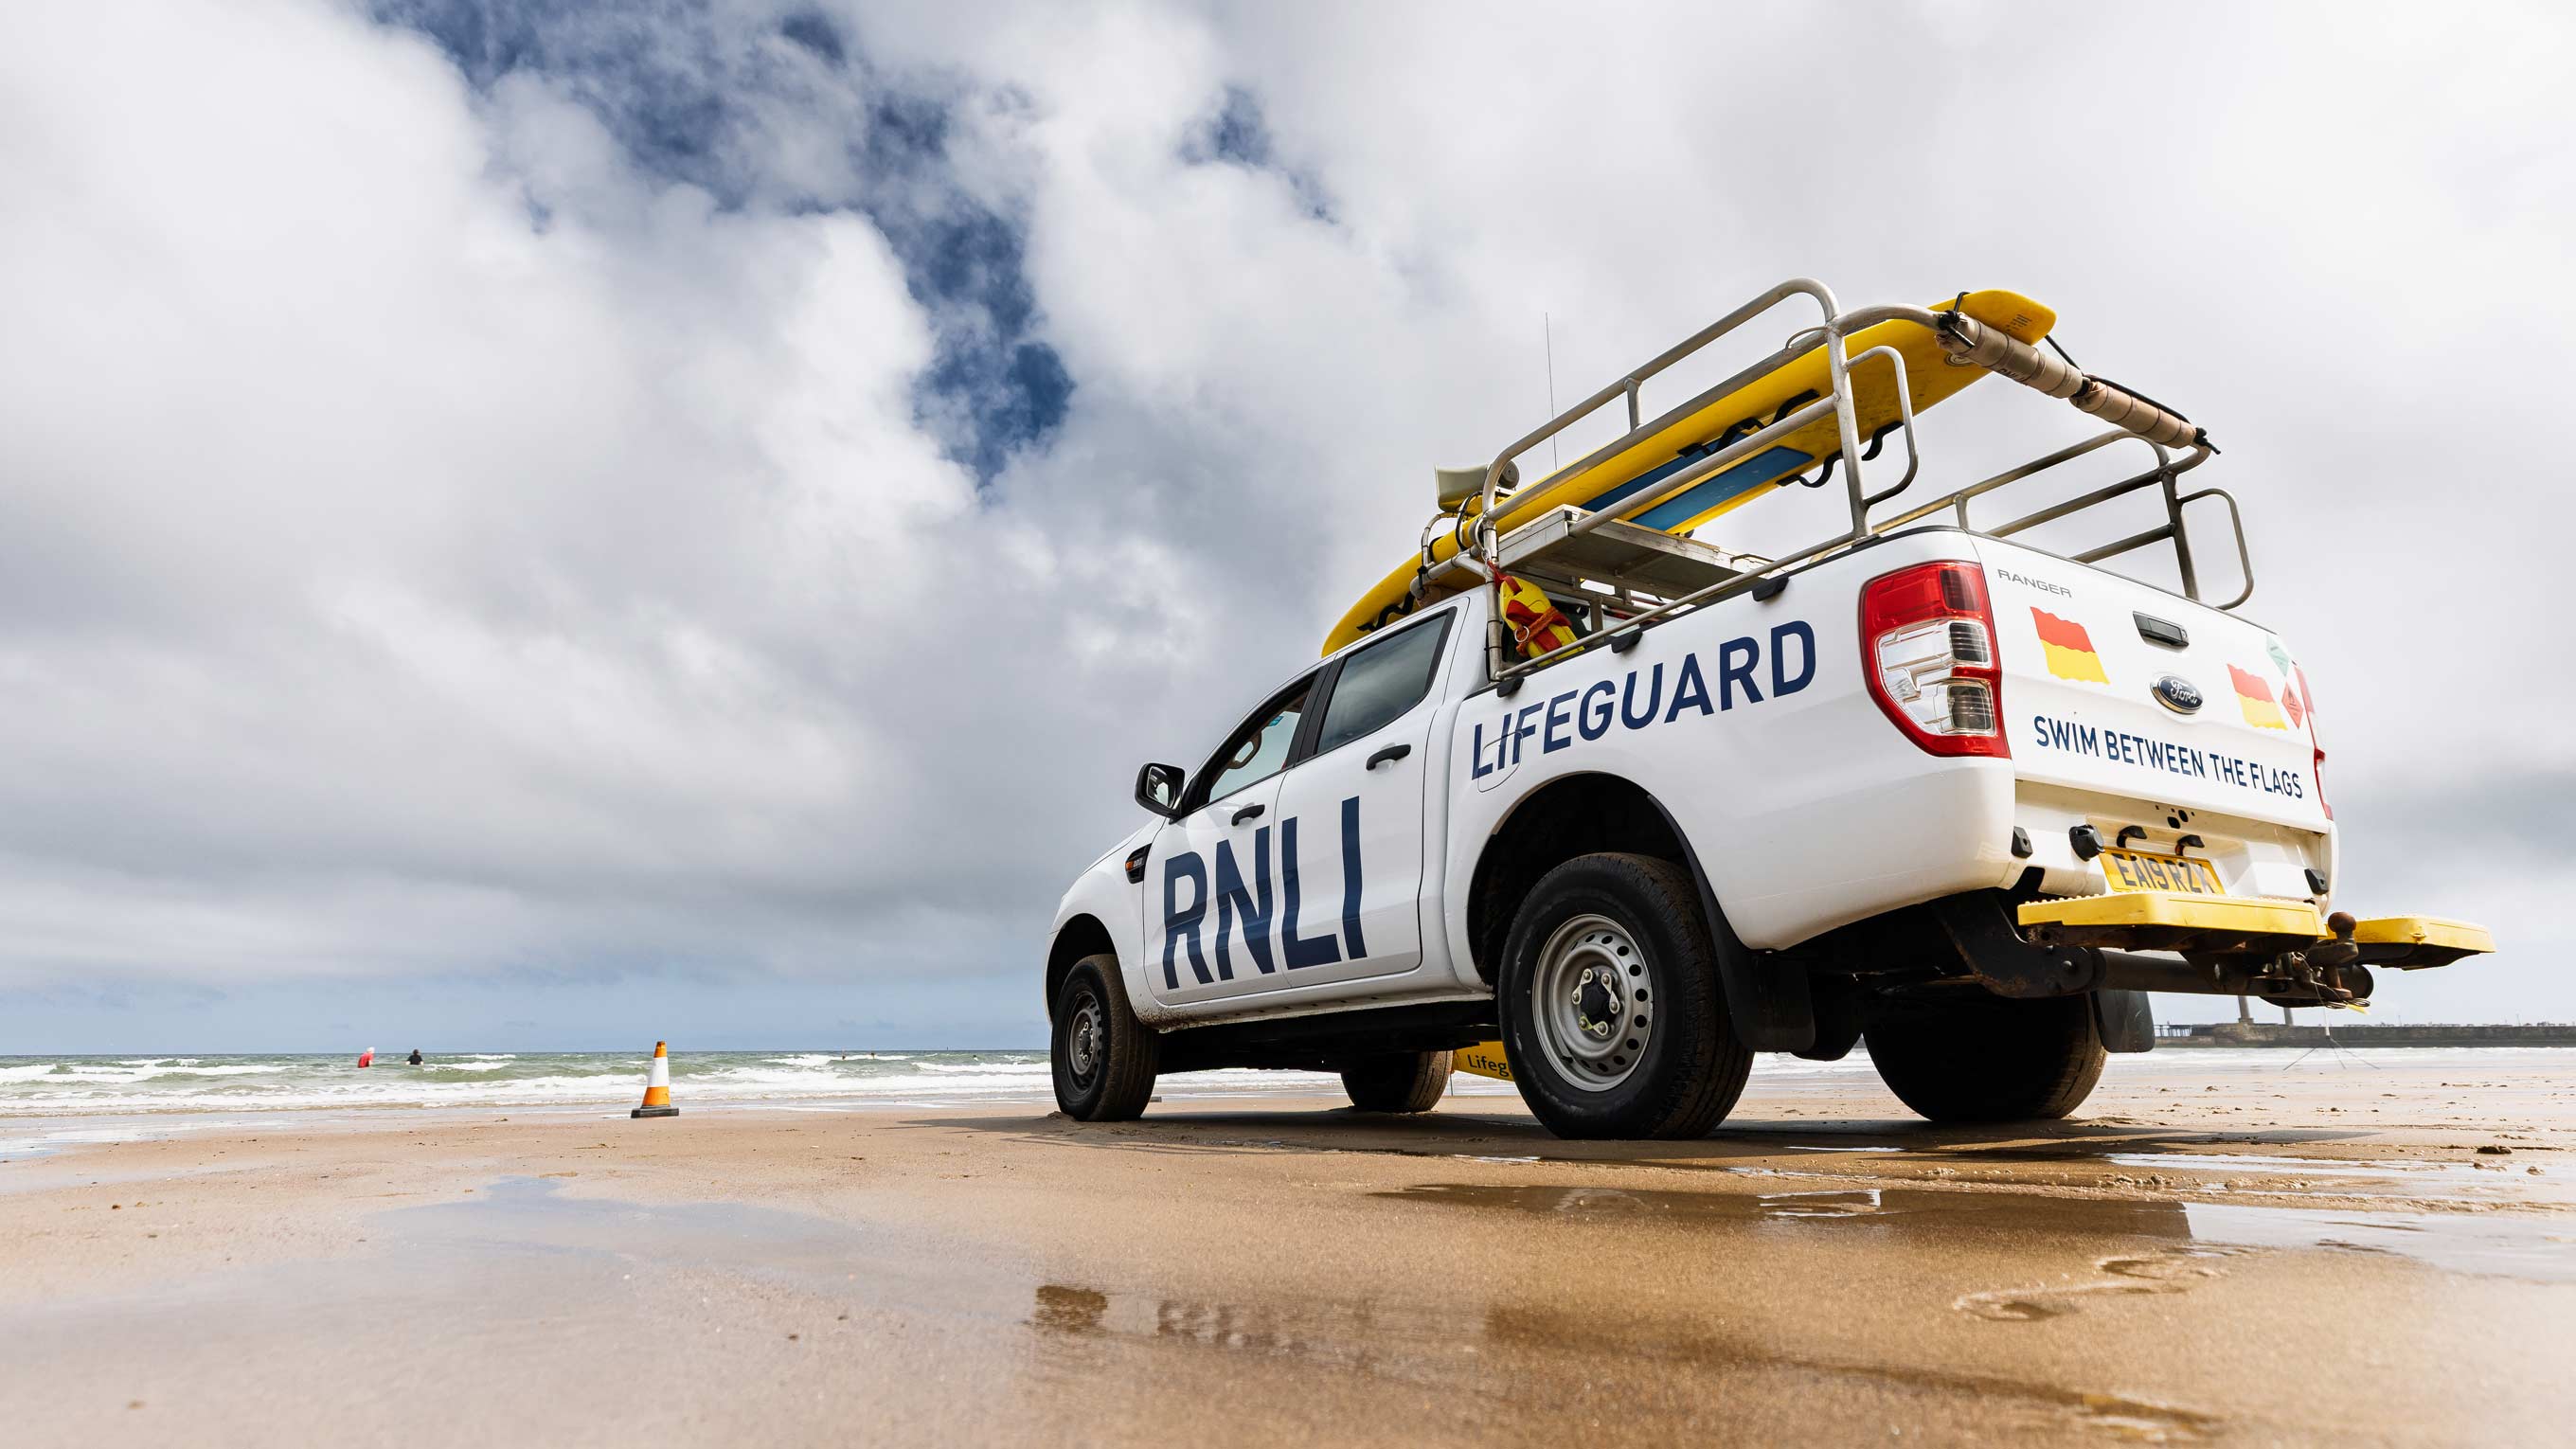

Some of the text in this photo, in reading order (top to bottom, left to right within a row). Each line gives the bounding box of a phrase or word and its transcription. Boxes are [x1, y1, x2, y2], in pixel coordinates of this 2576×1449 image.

[1997, 568, 2072, 598] RANGER
[1472, 620, 1816, 780] LIFEGUARD
[2170, 679, 2198, 705] Ford
[2033, 715, 2303, 798] SWIM BETWEEN THE FLAGS
[1162, 796, 1368, 990] RNLI
[2111, 852, 2169, 890] EA19
